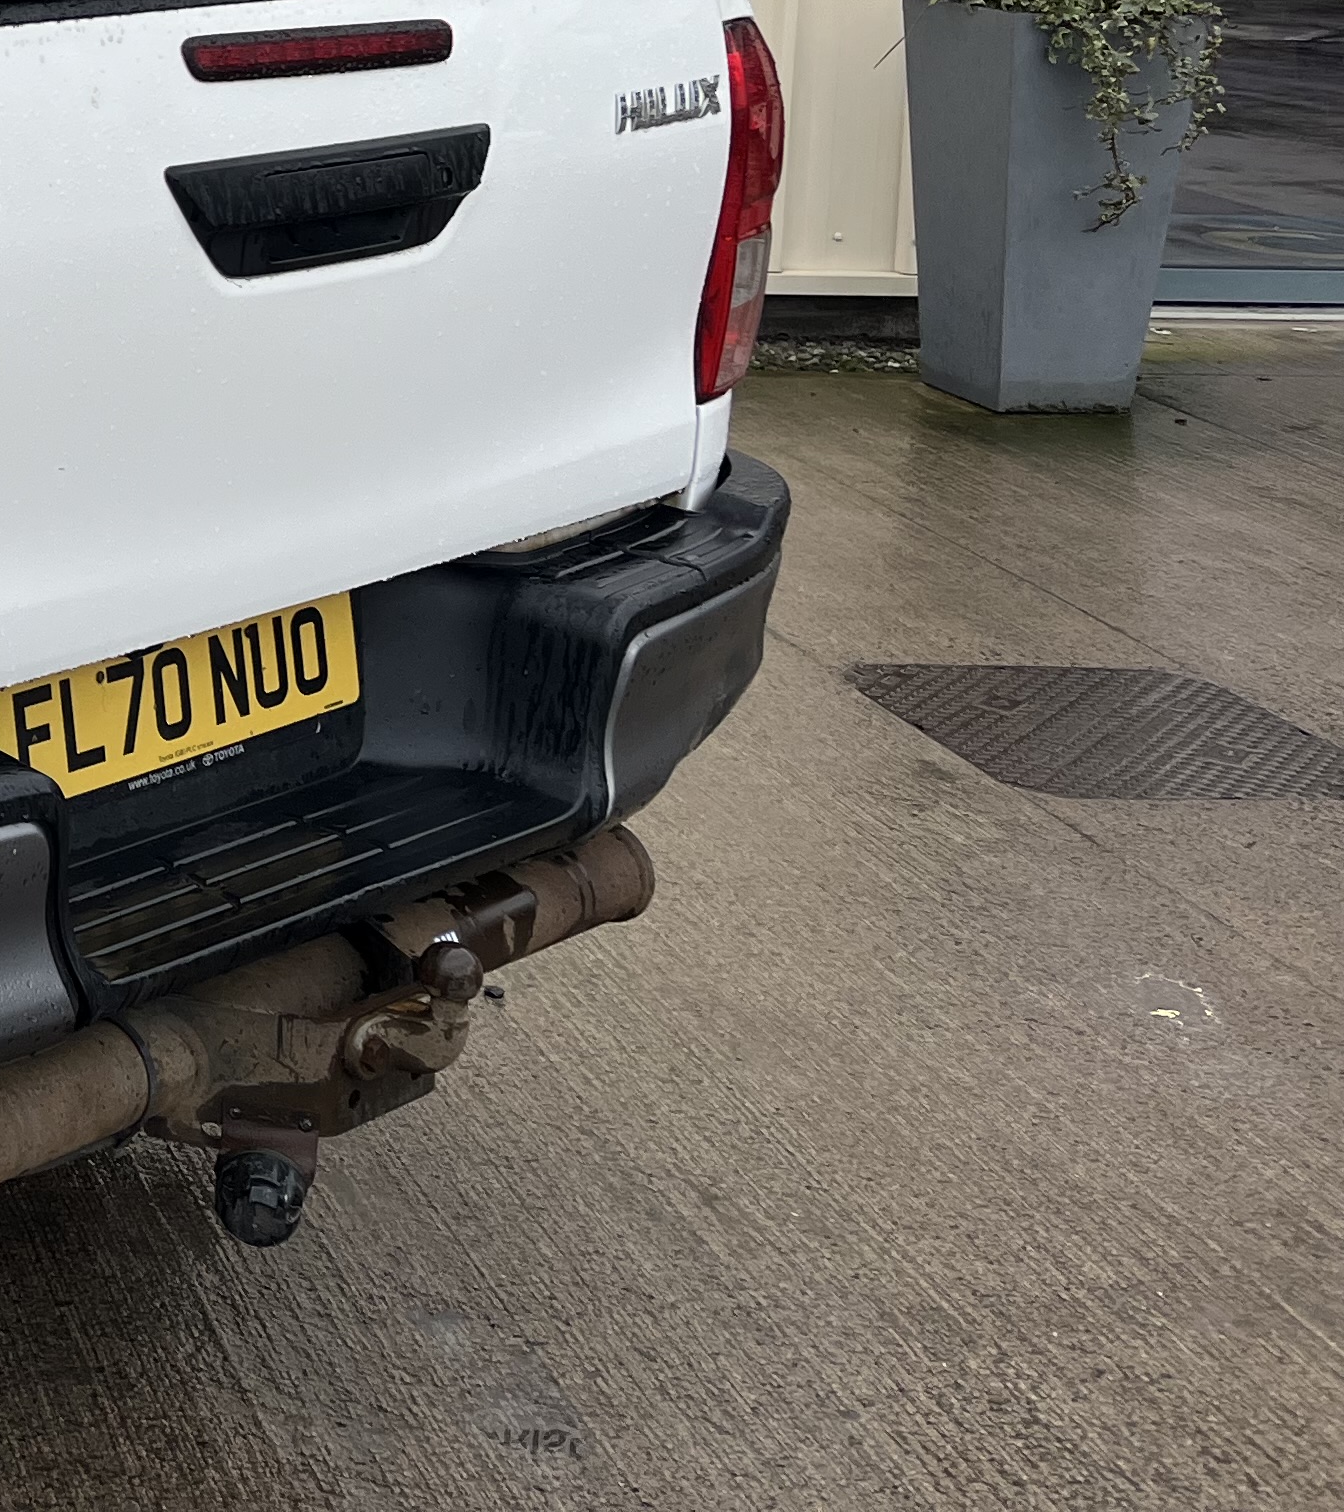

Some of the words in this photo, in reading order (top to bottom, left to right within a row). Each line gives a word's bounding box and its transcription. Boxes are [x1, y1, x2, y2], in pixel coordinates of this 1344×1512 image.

[614, 74, 721, 135] HILUX
[11, 646, 193, 774] FL70
[207, 605, 329, 726] NUO
[214, 744, 245, 762] TOYOTA
